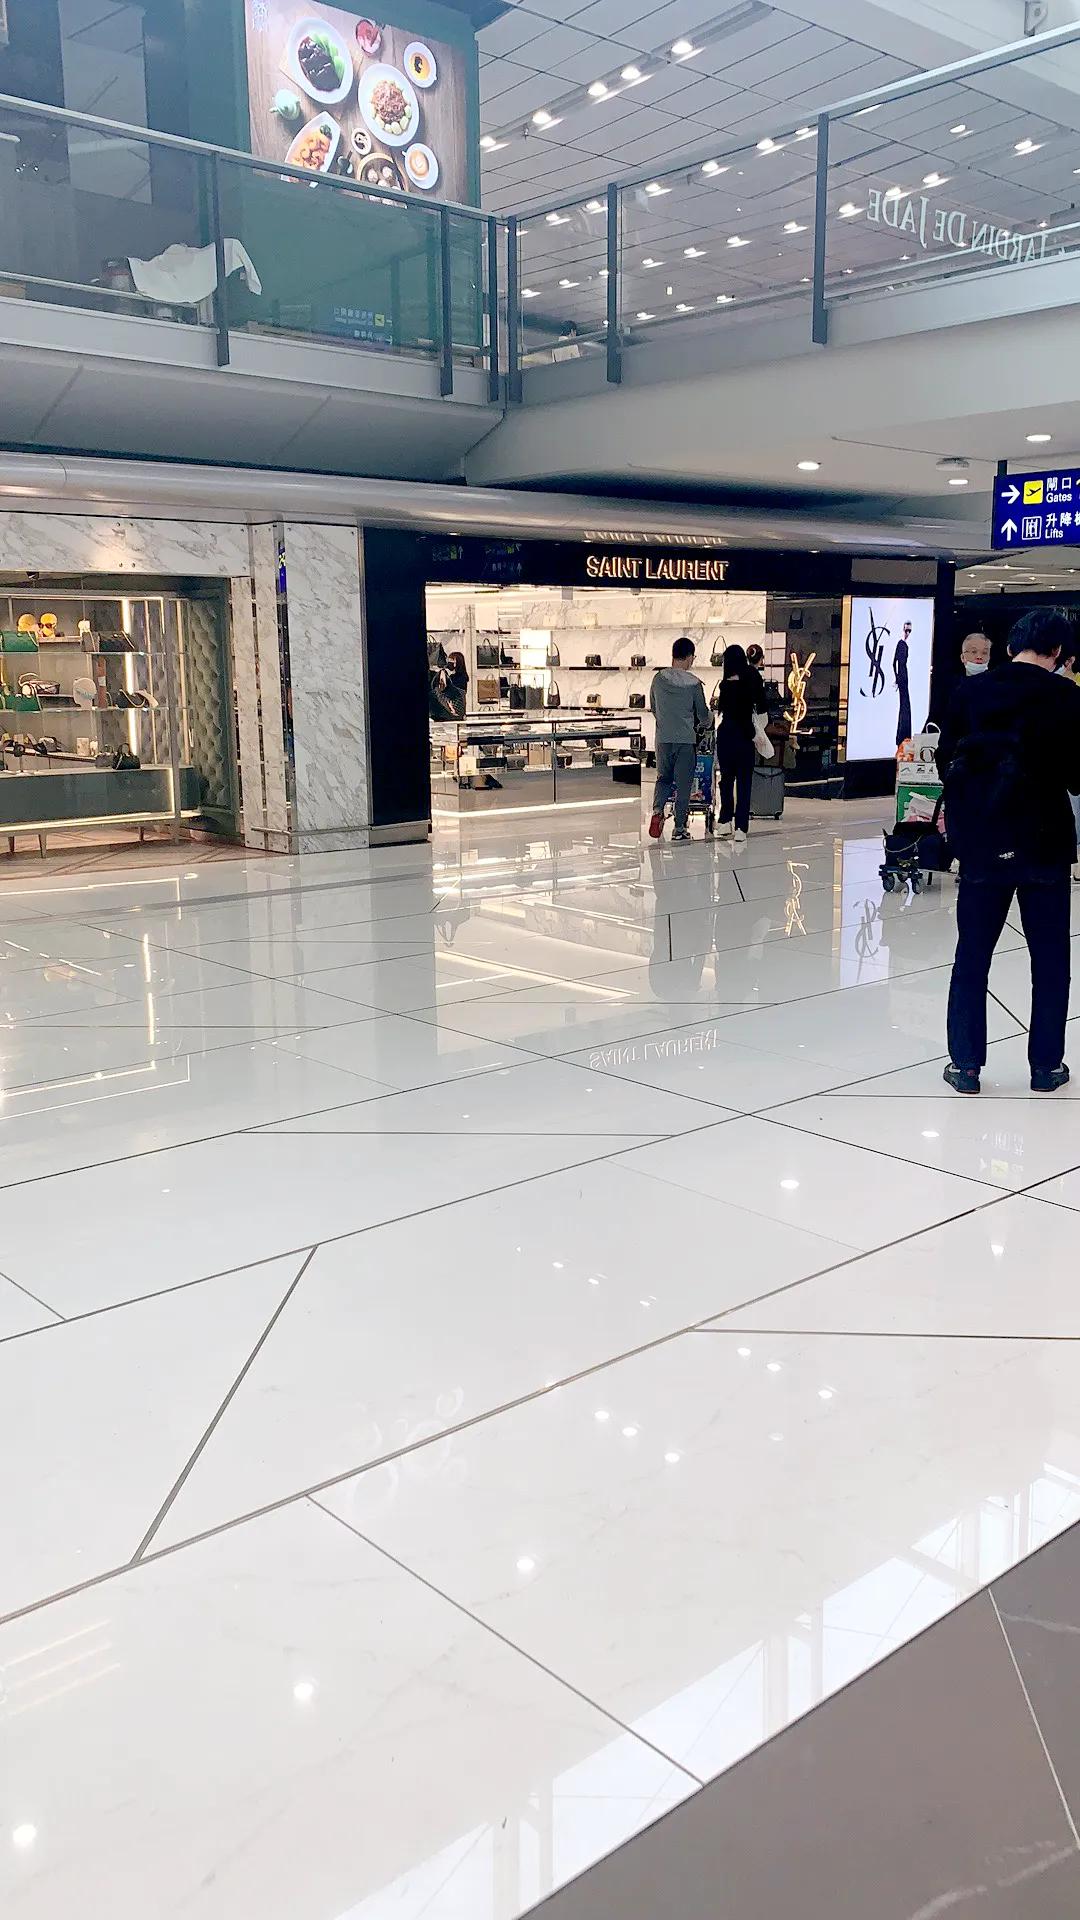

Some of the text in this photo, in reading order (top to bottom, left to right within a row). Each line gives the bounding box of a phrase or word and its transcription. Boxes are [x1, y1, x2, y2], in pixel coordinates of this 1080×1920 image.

[1046, 476, 1072, 492] 閘口
[1045, 492, 1073, 504] Gates
[1044, 527, 1064, 539] Lifts
[586, 555, 729, 581] SAINT LAURENT
